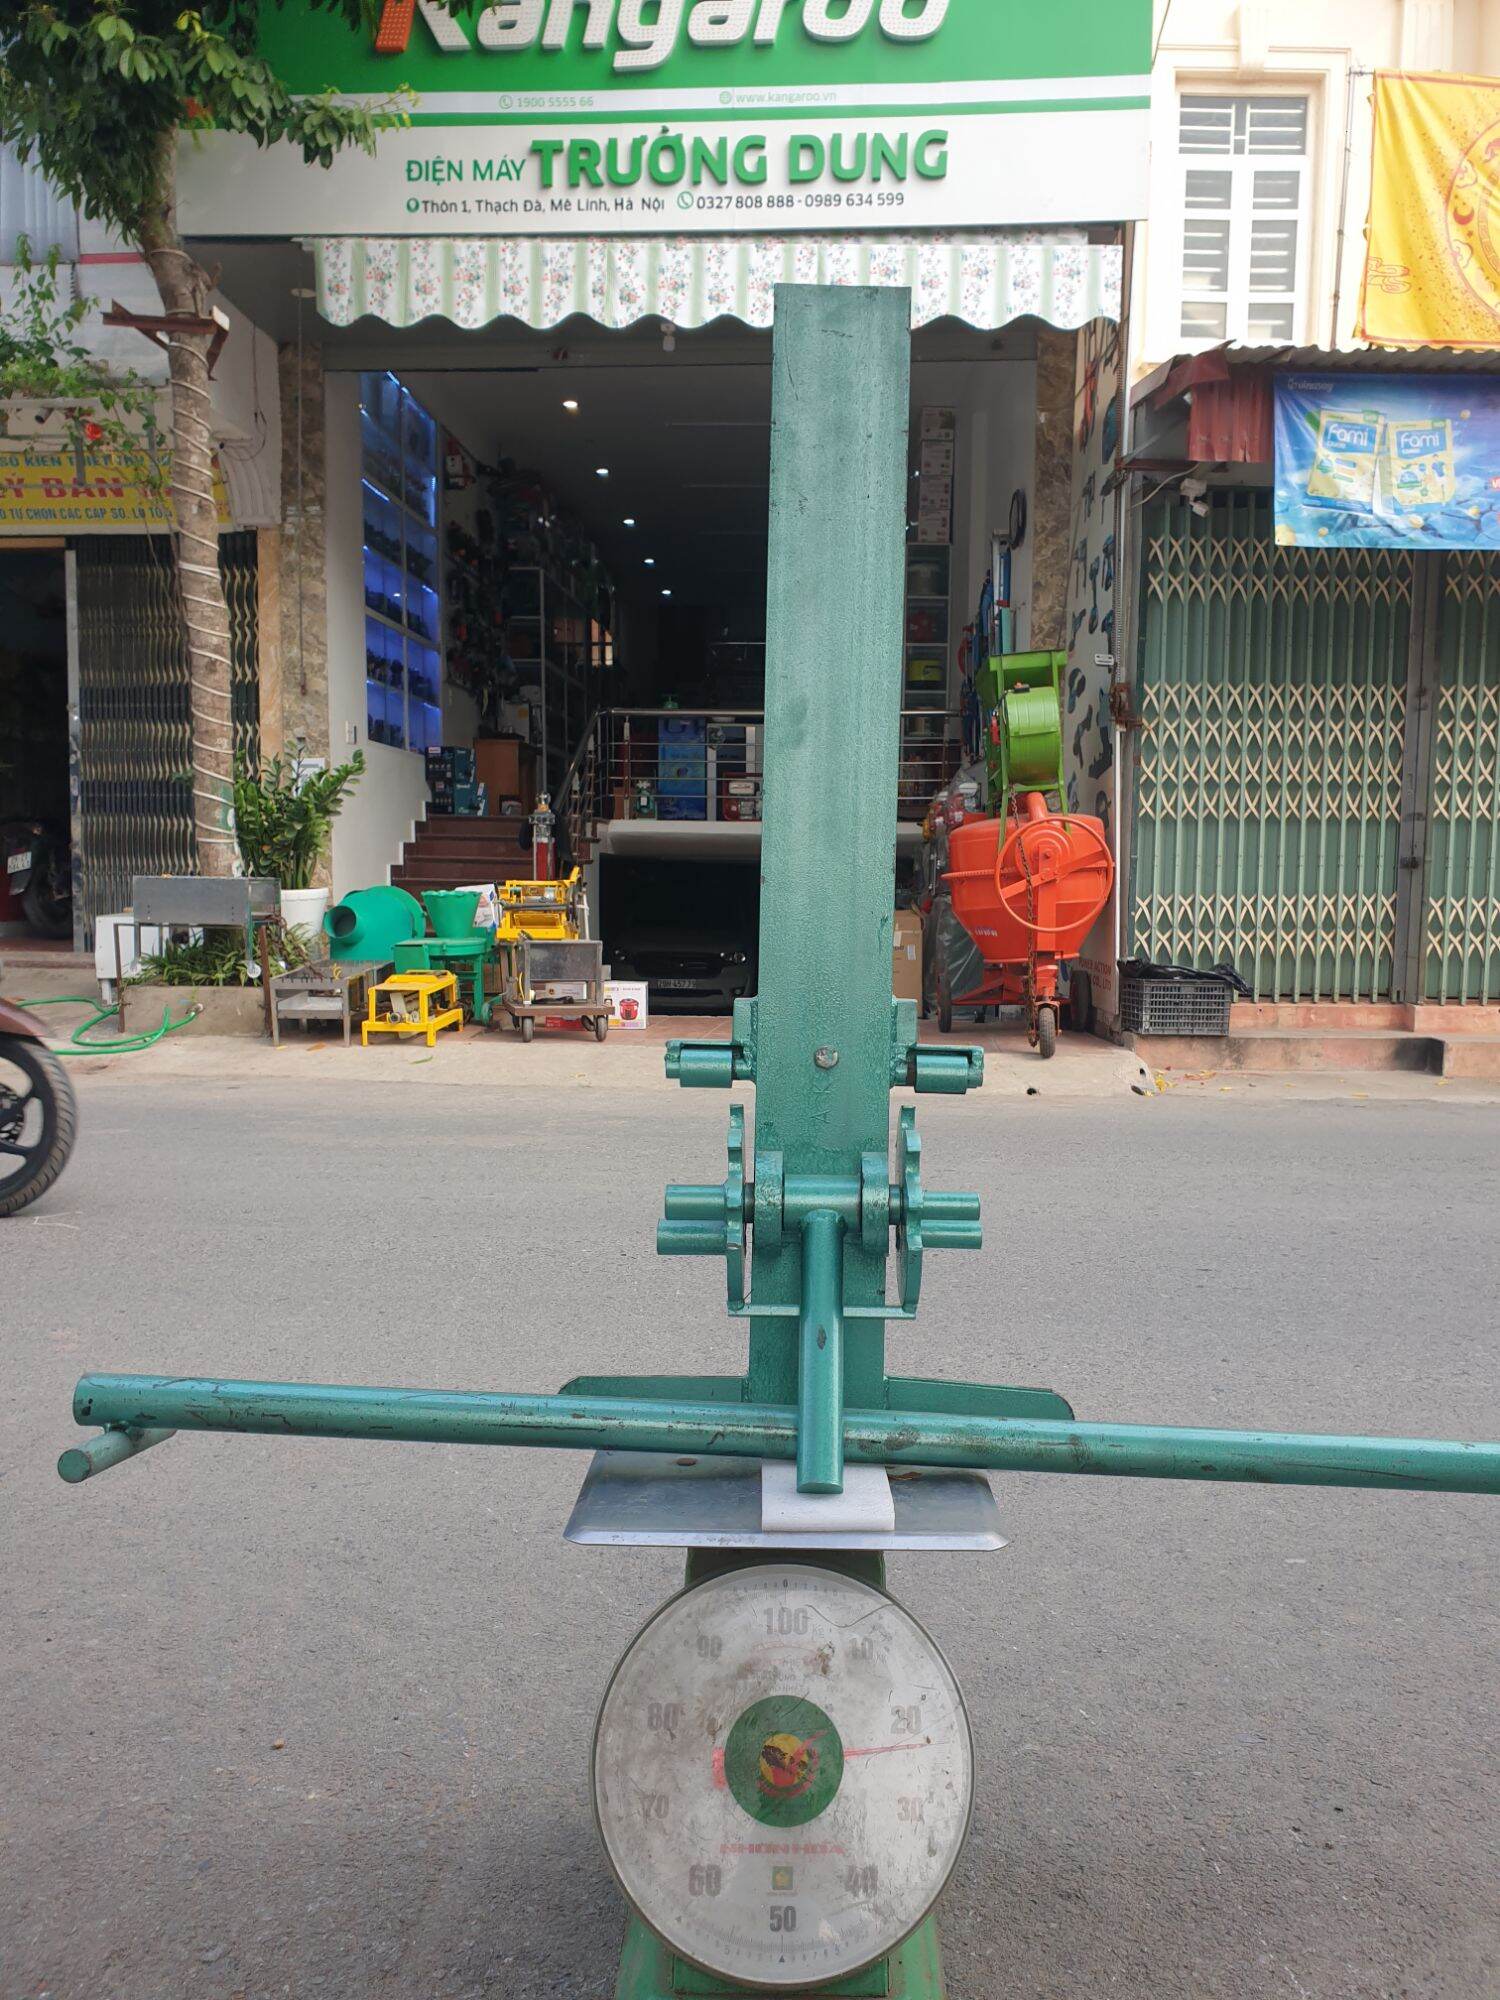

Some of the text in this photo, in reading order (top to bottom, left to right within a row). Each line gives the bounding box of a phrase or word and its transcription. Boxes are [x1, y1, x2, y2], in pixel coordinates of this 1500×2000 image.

[516, 96, 594, 107] 1900 5555 66
[735, 91, 838, 105] www.kangaroo.vn
[406, 155, 464, 186] ĐIỆN
[472, 154, 527, 182] MÁY
[788, 129, 949, 185] DUNG
[422, 199, 458, 213] Thôn
[475, 199, 519, 215] Thạch
[550, 198, 573, 212] Mê
[614, 196, 634, 211] Hà
[641, 197, 666, 213] Nội
[696, 196, 732, 209] 0327
[735, 195, 763, 209] 808
[766, 194, 795, 208] 888
[804, 193, 842, 208] 0989
[845, 193, 874, 207] 634
[876, 192, 905, 206] 599
[764, 1607, 809, 1636] 100
[696, 1635, 723, 1659] 90
[647, 1702, 680, 1731] 80
[891, 1705, 921, 1734] 20
[897, 1796, 923, 1821] 30
[688, 1863, 722, 1898] 60
[845, 1862, 879, 1898] 40
[769, 1904, 797, 1933] 50
